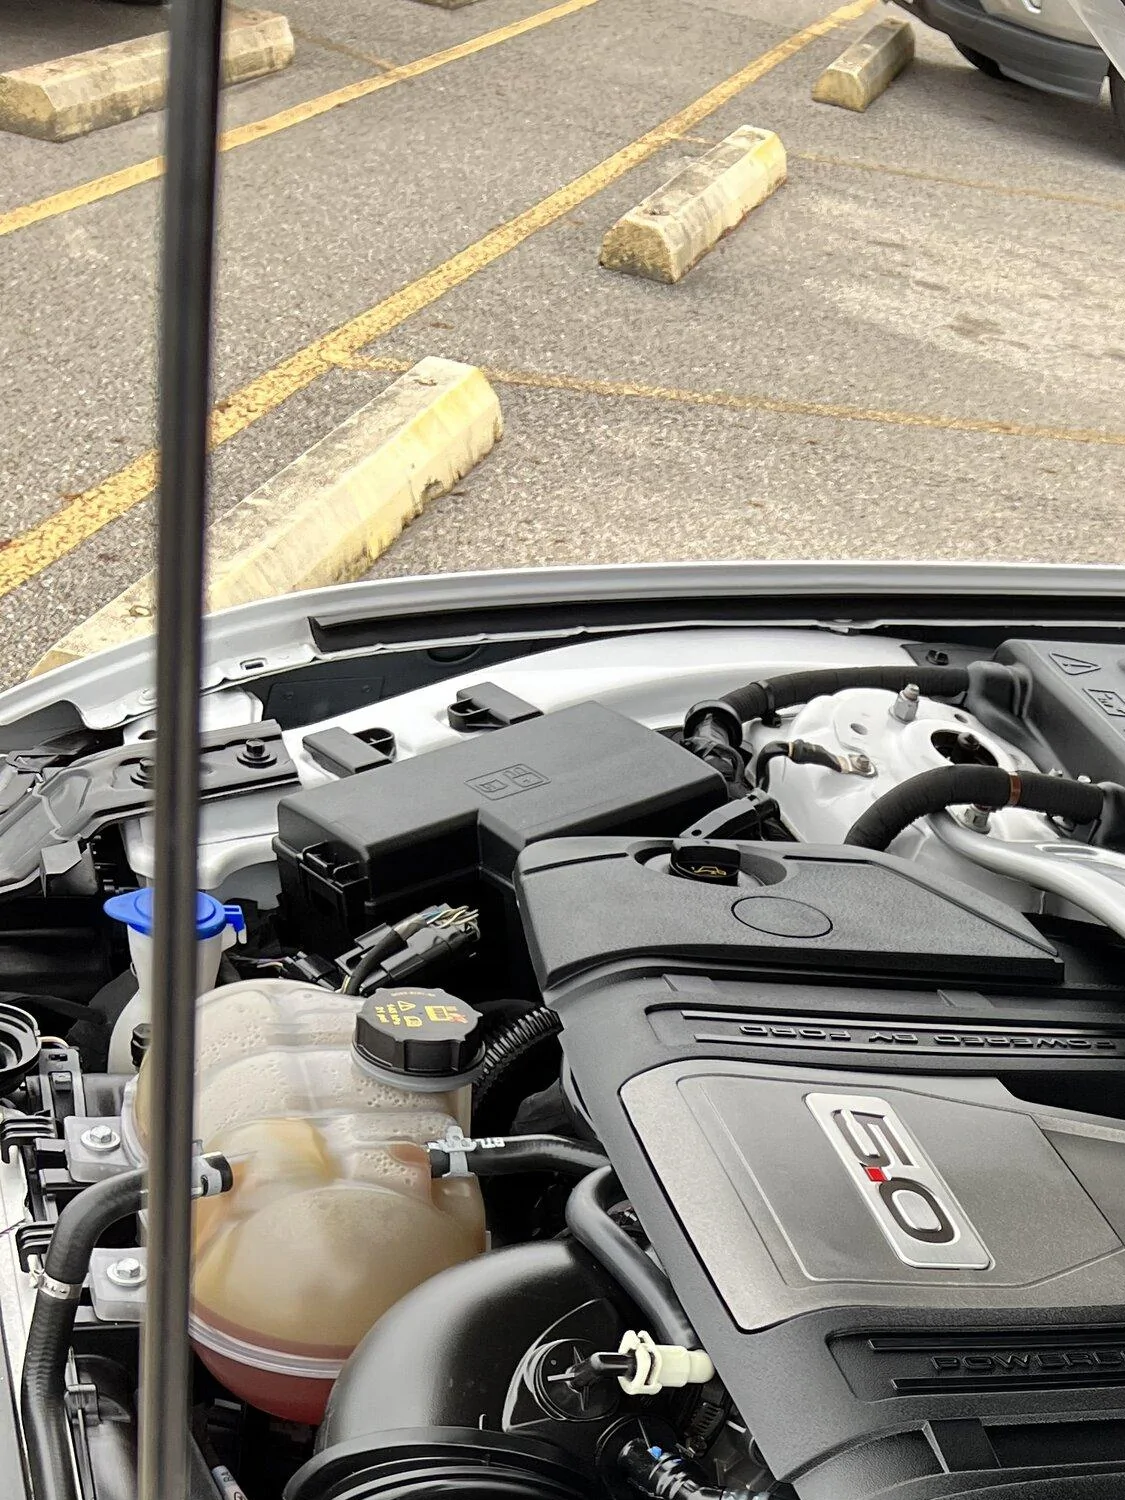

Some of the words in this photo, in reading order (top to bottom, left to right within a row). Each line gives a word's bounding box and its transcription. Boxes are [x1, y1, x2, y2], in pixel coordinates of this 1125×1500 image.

[738, 1024, 852, 1041] FORD
[868, 1032, 919, 1044] BY
[933, 1035, 1116, 1049] POWERED
[831, 1108, 958, 1246] 5.0
